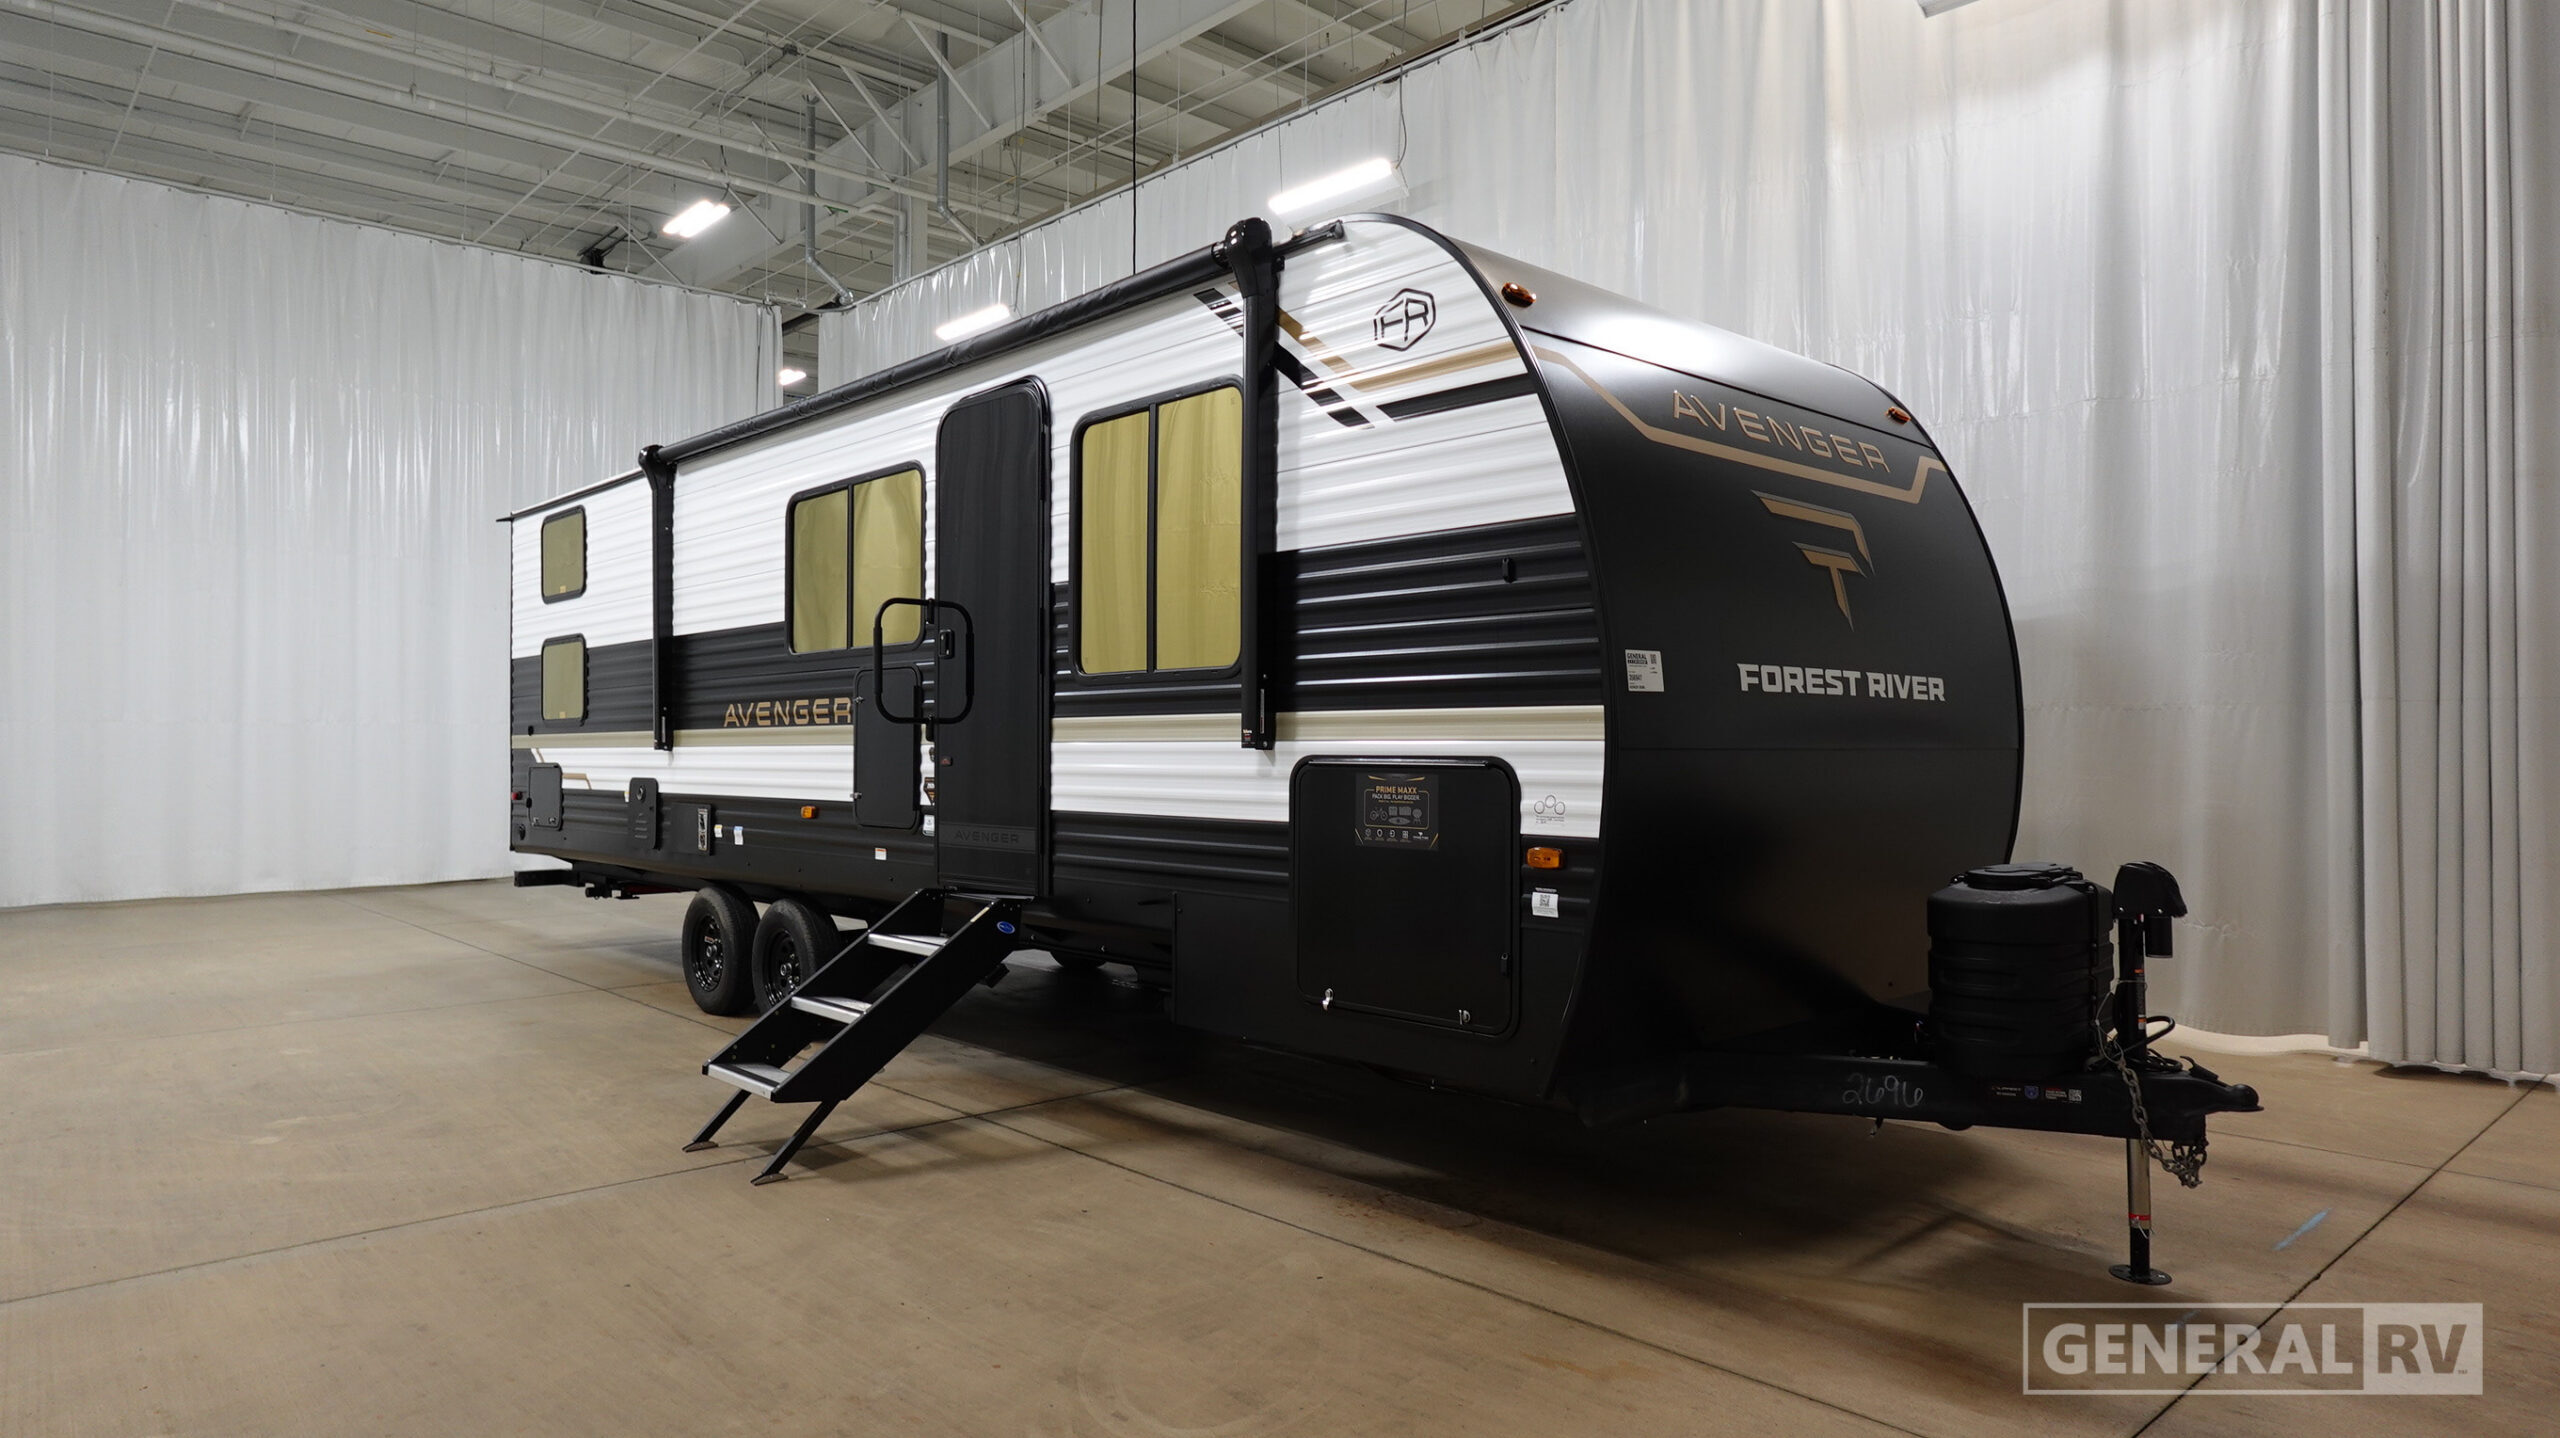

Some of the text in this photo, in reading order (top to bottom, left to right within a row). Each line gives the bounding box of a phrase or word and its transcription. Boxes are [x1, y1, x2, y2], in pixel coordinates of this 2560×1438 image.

[1672, 389, 1891, 474] AVENGER
[1737, 663, 1946, 702] FOREST RIVER
[723, 696, 852, 728] AVENGER
[954, 829, 1019, 844] AVENGER
[1842, 1072, 1924, 1108] 2696
